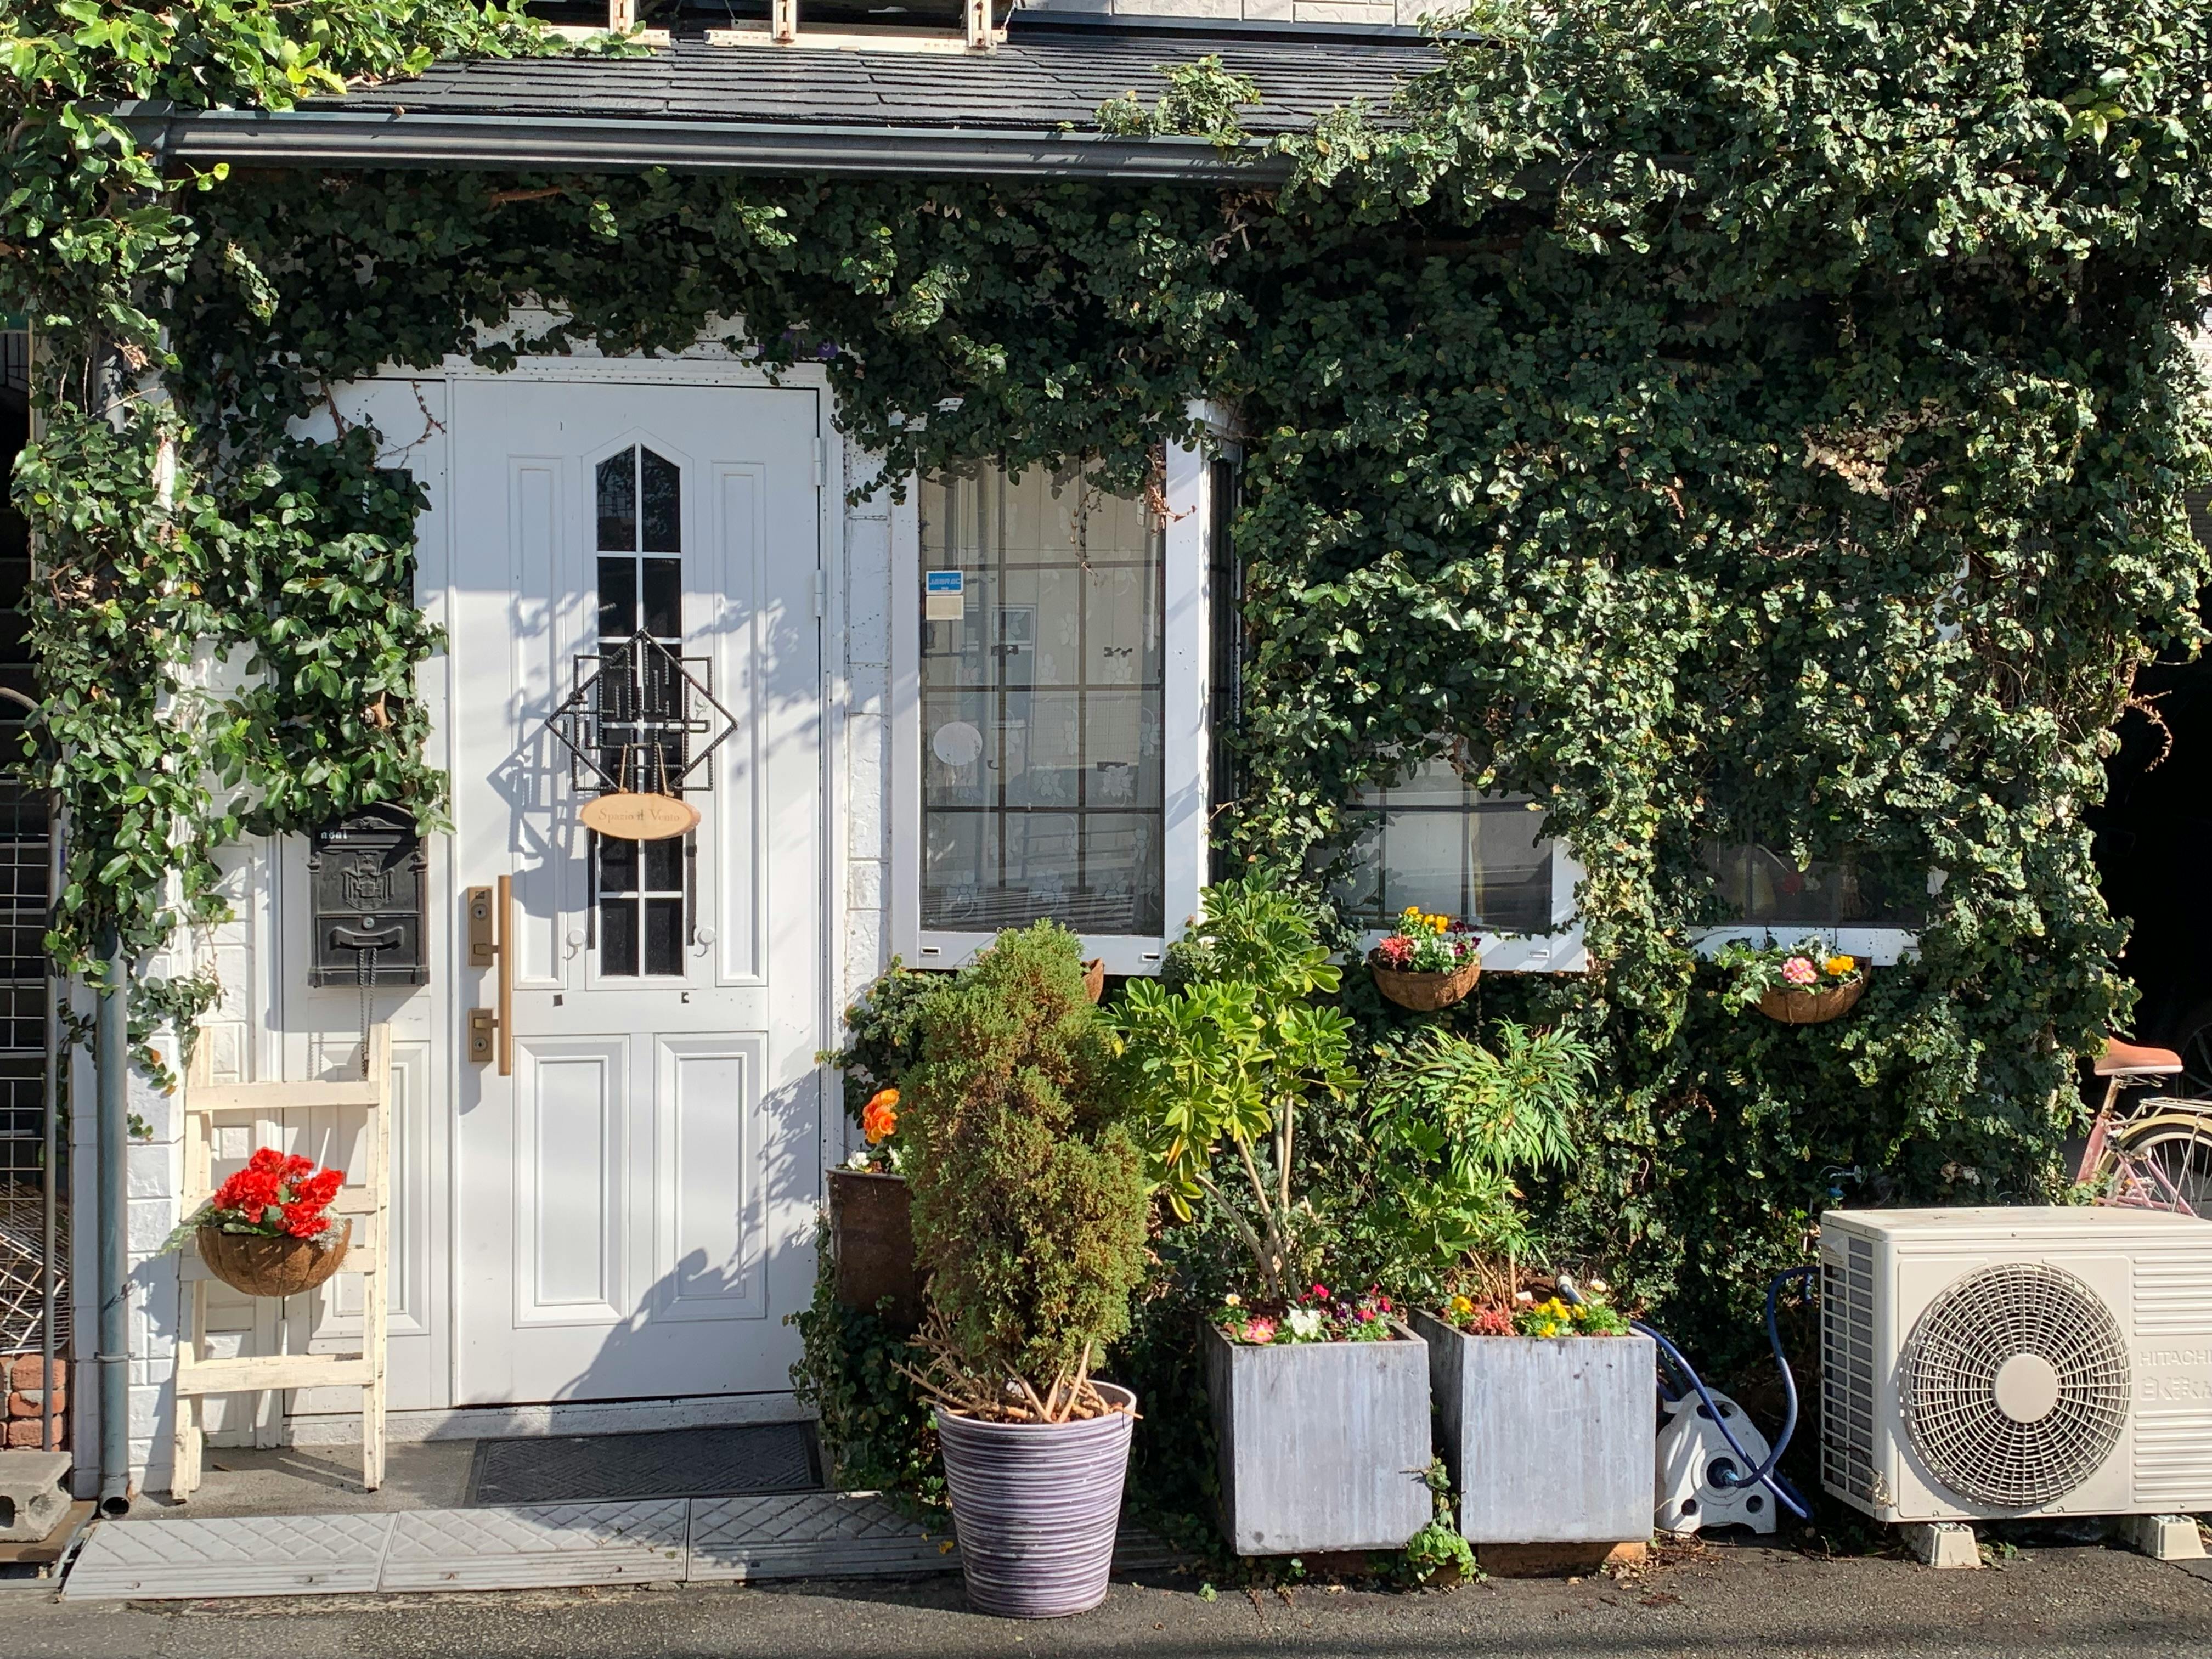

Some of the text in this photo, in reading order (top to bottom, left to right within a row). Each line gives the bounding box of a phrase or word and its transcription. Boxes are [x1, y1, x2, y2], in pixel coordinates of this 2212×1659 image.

[597, 807, 634, 823] Spazio
[650, 809, 680, 822] Vento
[2139, 1350, 2212, 1367] HITACHI
